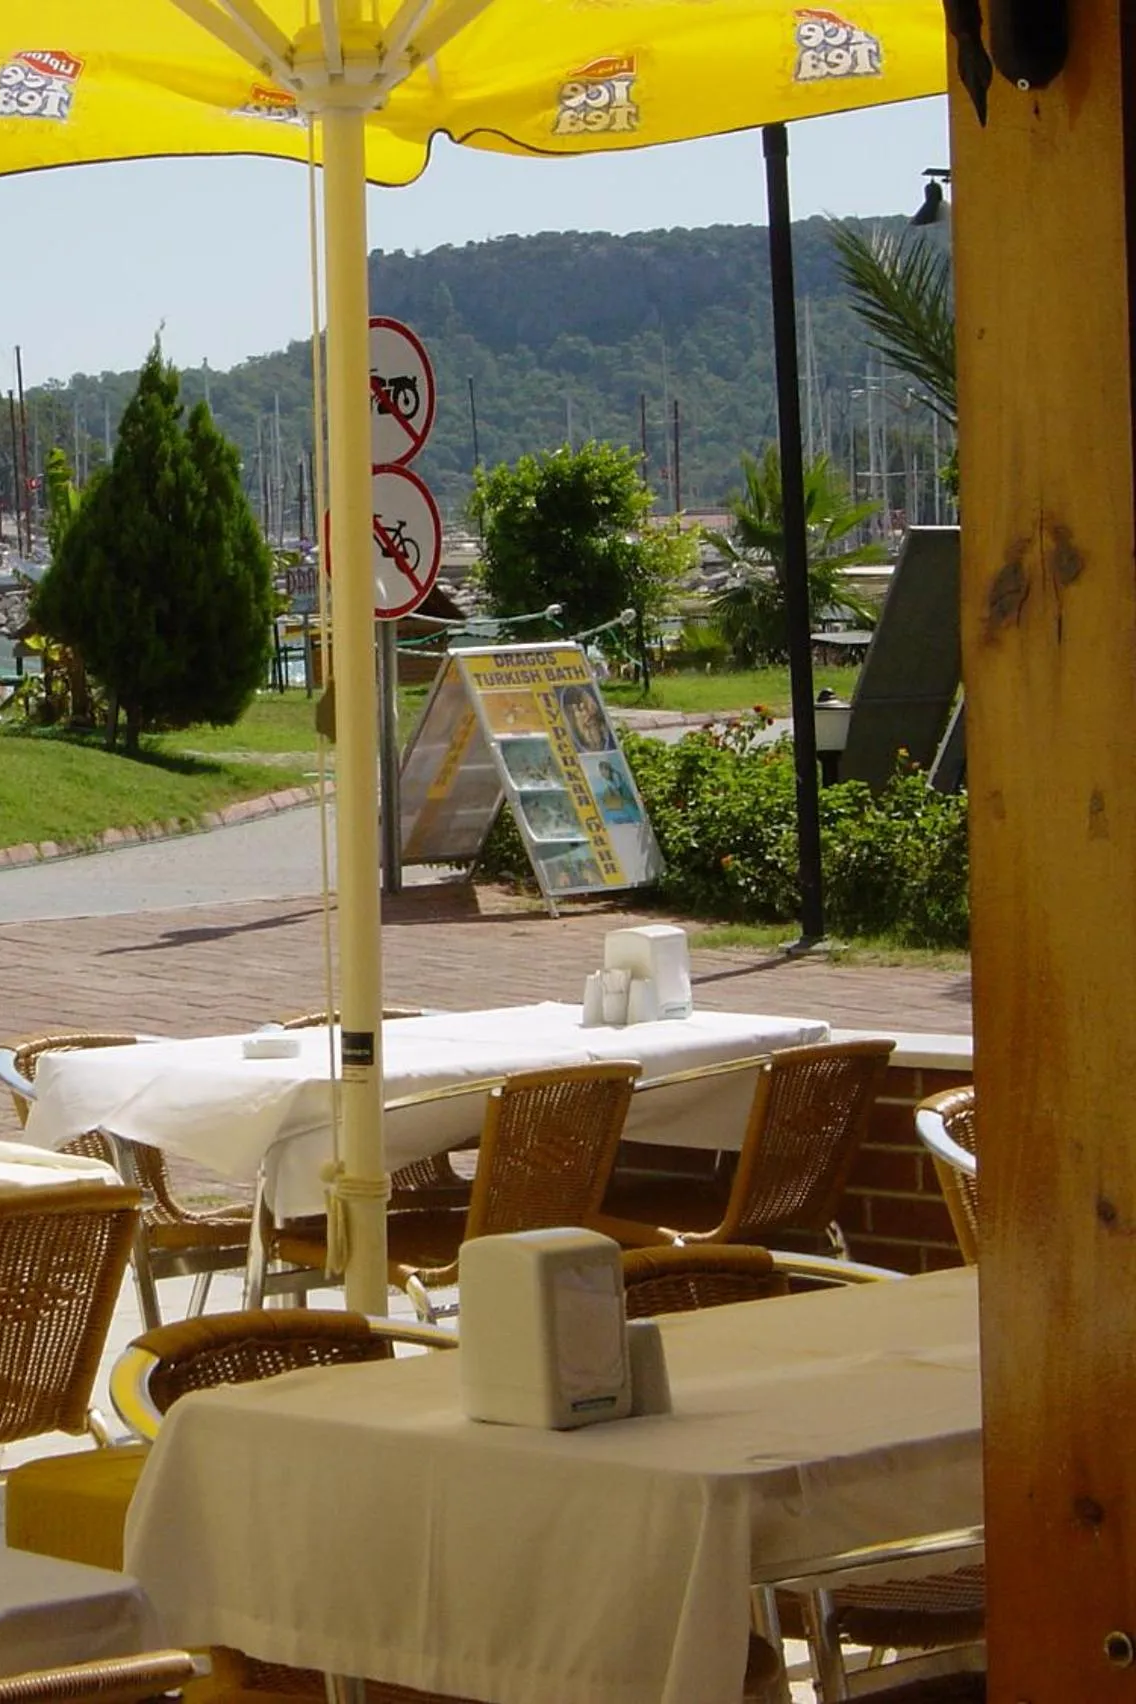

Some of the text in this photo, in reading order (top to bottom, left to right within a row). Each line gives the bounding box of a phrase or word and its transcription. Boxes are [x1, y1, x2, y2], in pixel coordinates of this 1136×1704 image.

[493, 651, 557, 668] DRAGOS
[472, 665, 588, 687] TURKISH BATH
